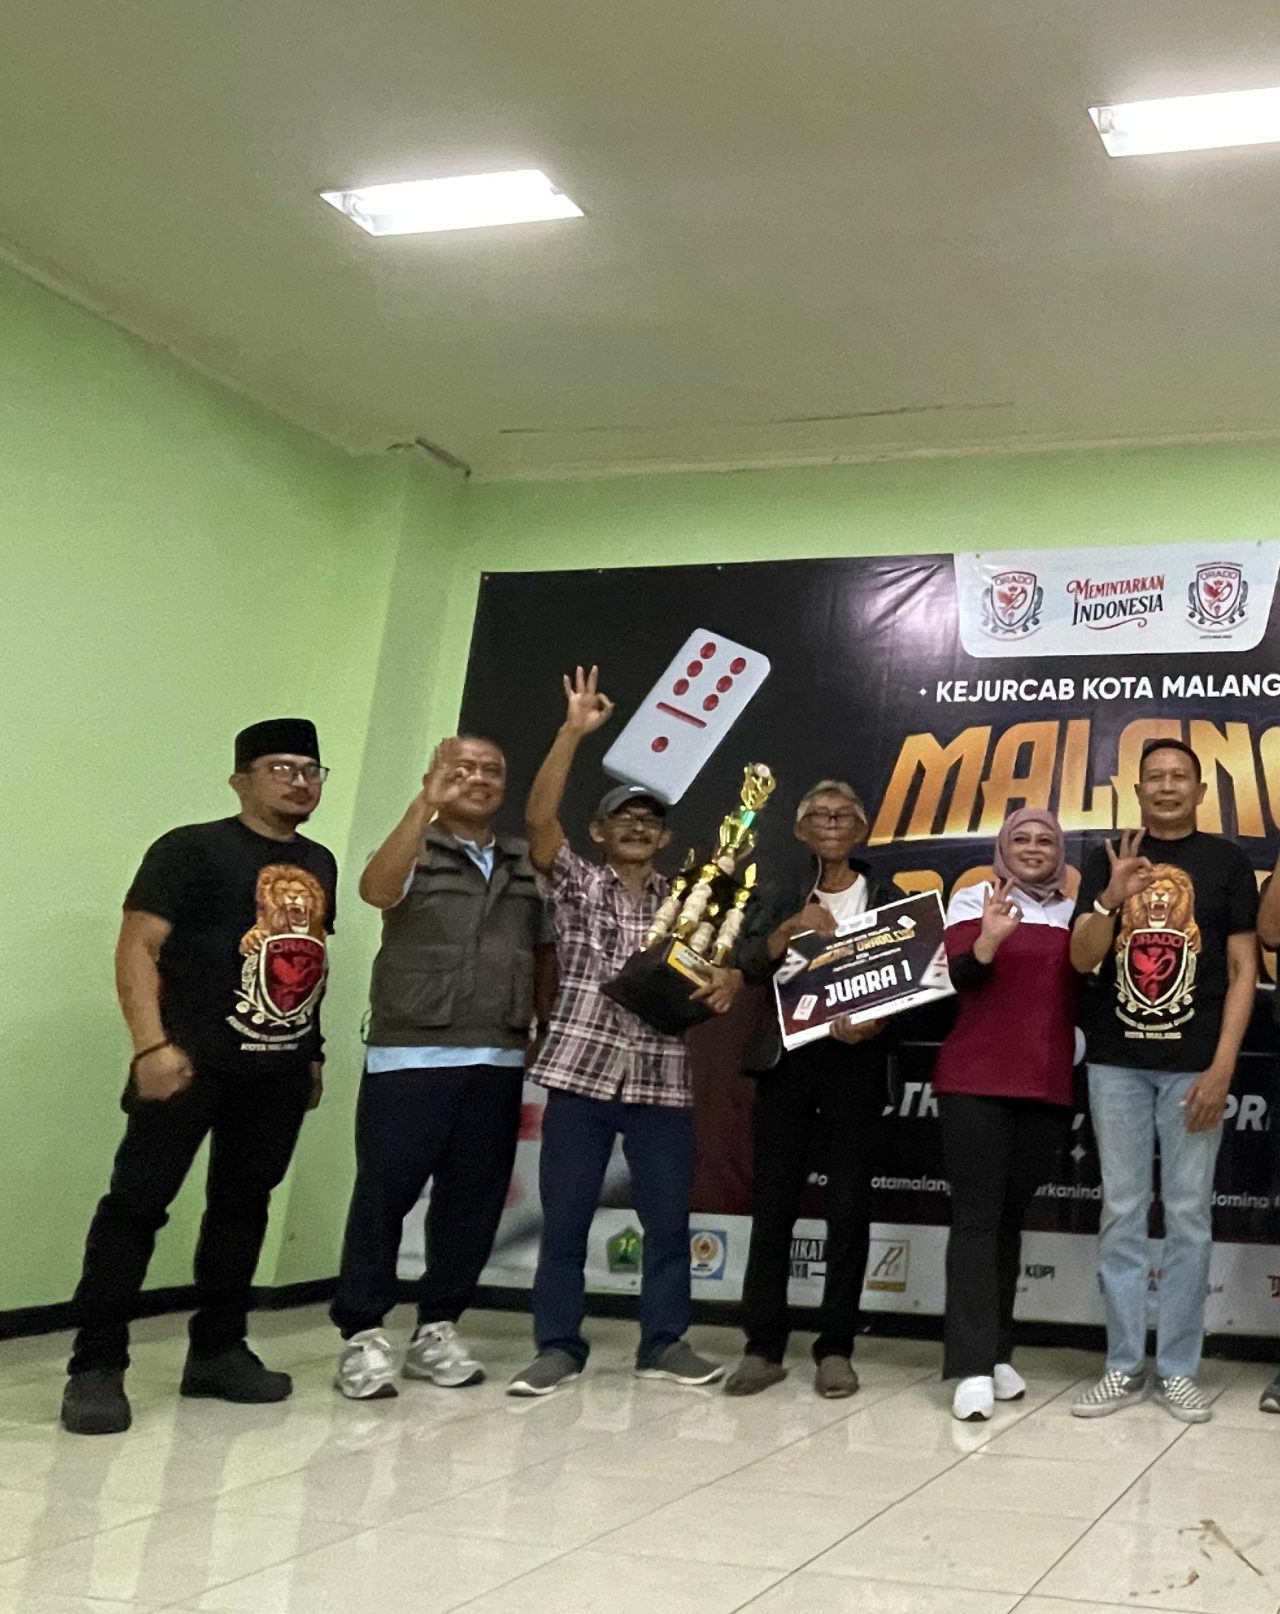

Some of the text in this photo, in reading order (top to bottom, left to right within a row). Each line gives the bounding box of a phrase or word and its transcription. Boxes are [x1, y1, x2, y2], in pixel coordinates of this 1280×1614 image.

[1066, 574, 1166, 601] MEMINTARKAN
[1072, 594, 1164, 626] INDONESIA
[936, 679, 1076, 703] KEJURCAB
[1082, 676, 1154, 700] KOTA
[824, 964, 898, 1007] JUARA
[901, 959, 913, 981] 1
